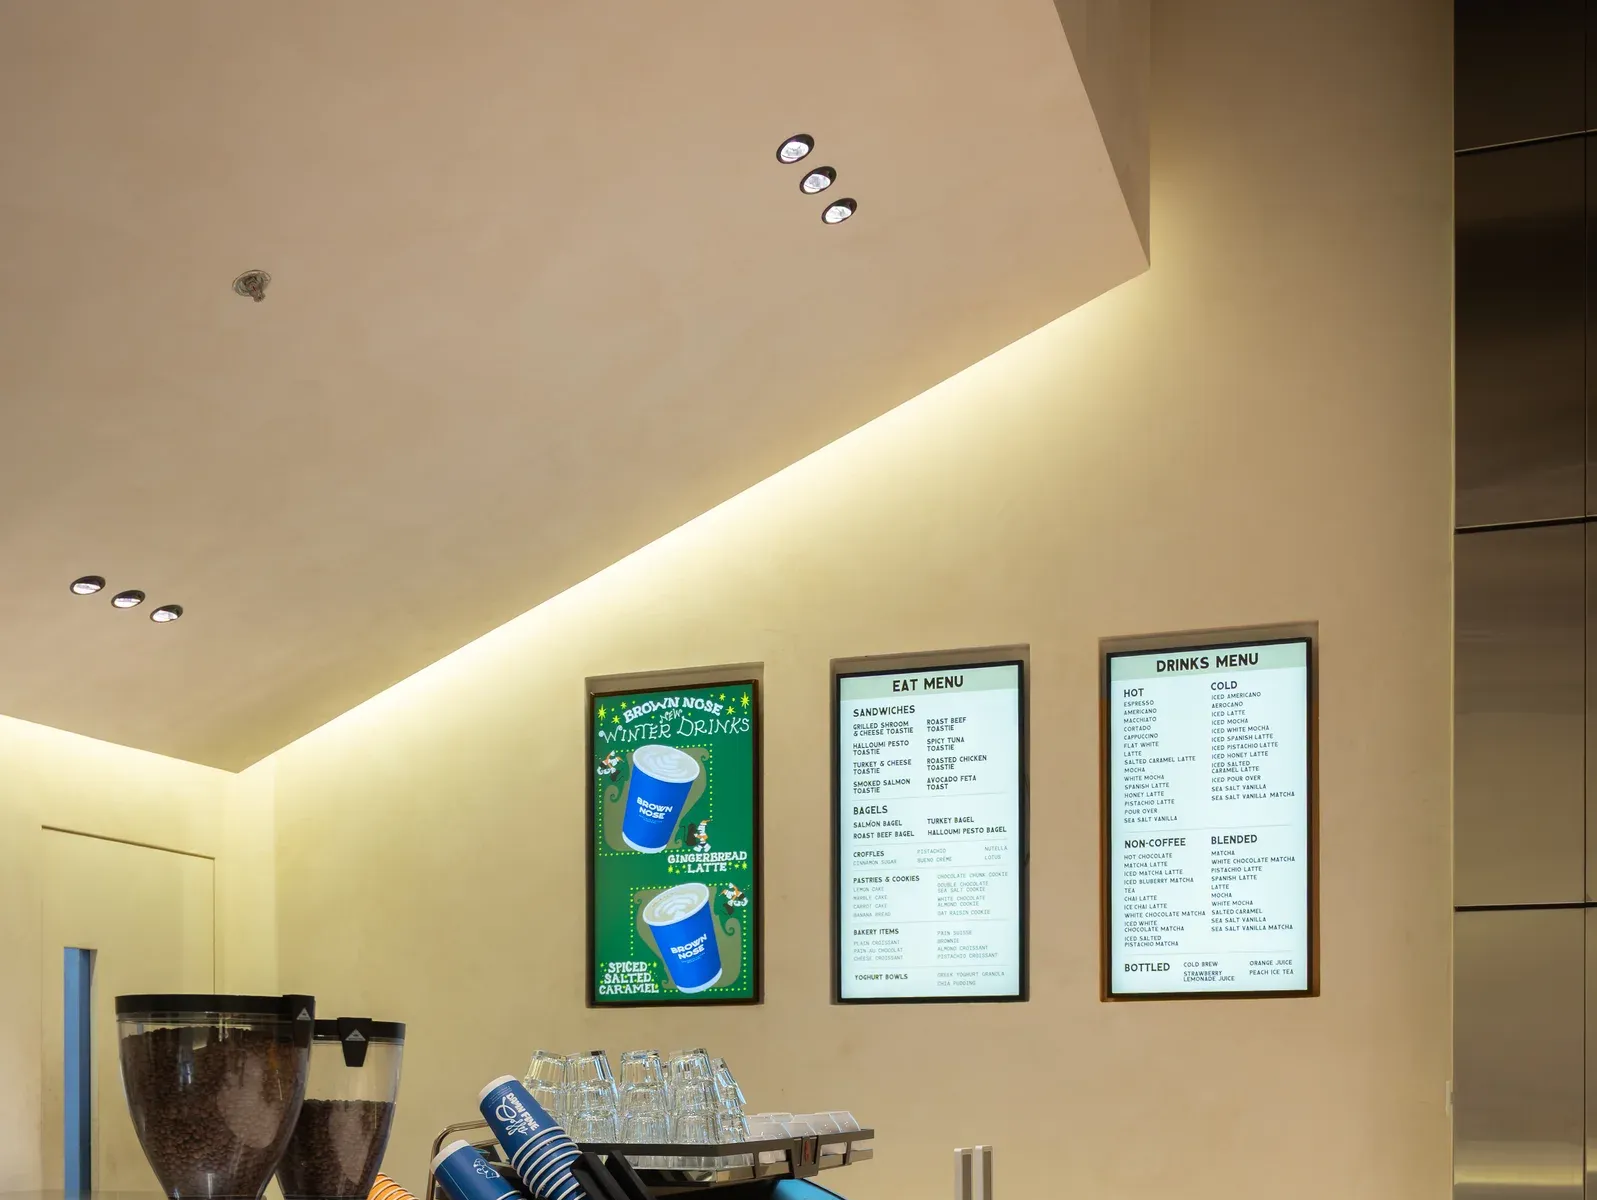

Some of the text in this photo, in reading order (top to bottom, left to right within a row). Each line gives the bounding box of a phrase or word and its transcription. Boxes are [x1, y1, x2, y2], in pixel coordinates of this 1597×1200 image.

[1156, 653, 1258, 672] DRINKS MENU
[892, 676, 964, 692] EAT MENU
[1211, 681, 1237, 690] COLD
[1124, 688, 1144, 697] HOT
[623, 697, 723, 723] BROWN NOSE
[660, 709, 682, 723] NEW
[853, 705, 915, 717] SANDWICHES
[598, 717, 750, 743] WINTER DRINKS
[853, 780, 881, 788] SMOKED
[637, 797, 673, 812] BROWN
[853, 805, 888, 815] BAGELS
[639, 807, 665, 820] NOSE
[928, 828, 961, 836] HALLOUMI
[1124, 838, 1186, 848] NON-COFFEE
[1211, 835, 1257, 844] BLENDED
[668, 851, 747, 864] GINGERBREAD
[687, 863, 727, 873] LATTE
[670, 934, 707, 954] BROWN
[678, 944, 705, 960] NOSE
[608, 961, 647, 973] SPICED
[1124, 963, 1170, 972] BOTTLED
[604, 973, 651, 984] SALTED
[599, 983, 659, 995] CARAMEL
[506, 1092, 540, 1131] DAMN FINE
